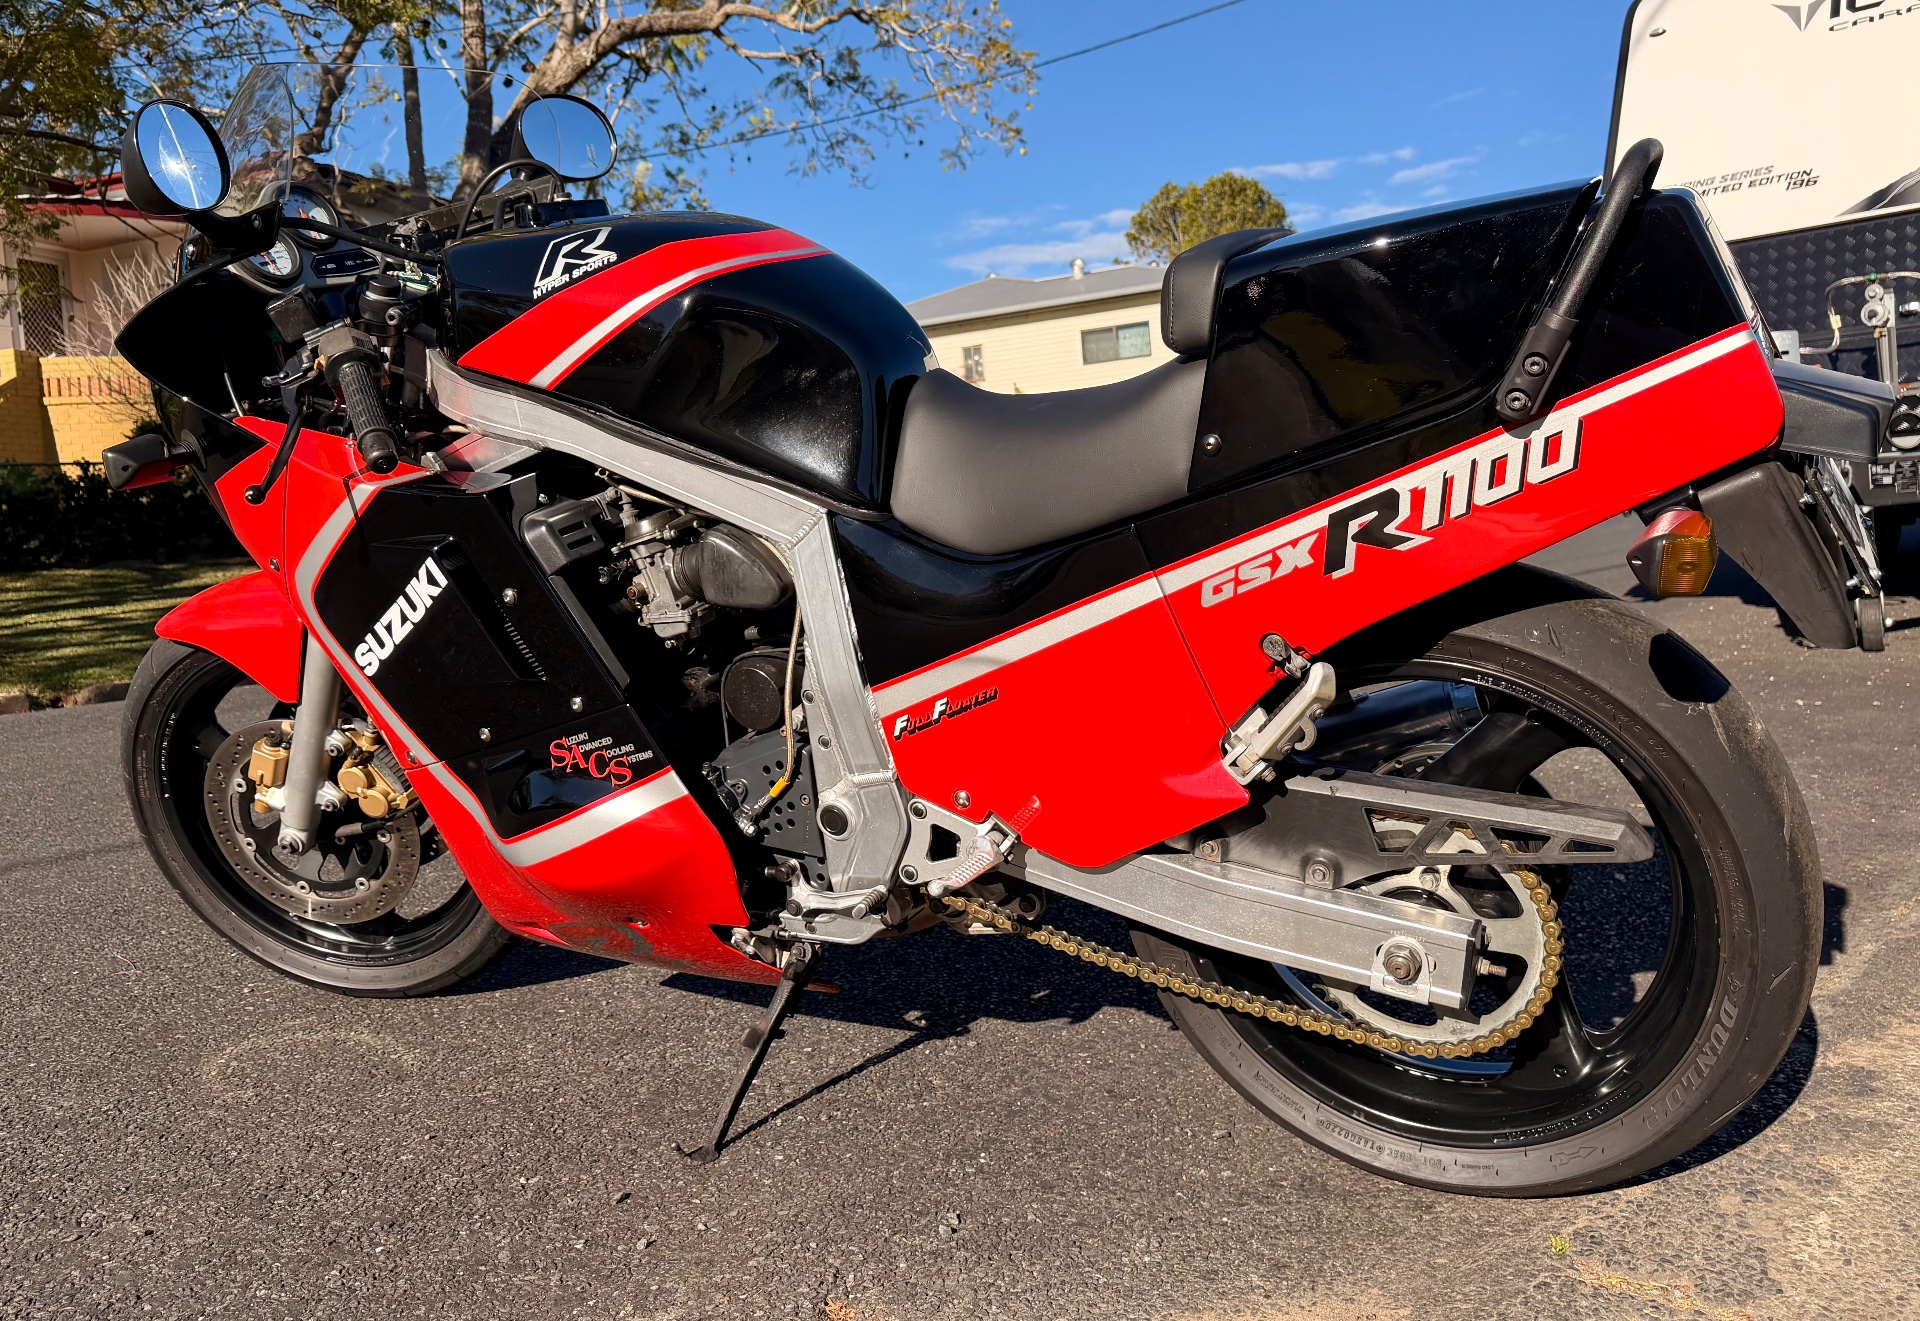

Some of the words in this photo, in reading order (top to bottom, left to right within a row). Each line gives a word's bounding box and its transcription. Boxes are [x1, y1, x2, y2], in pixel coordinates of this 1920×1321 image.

[1719, 165, 1775, 184] SERIES
[1748, 168, 1814, 188] EDITION
[1786, 175, 1820, 191] 196
[533, 273, 570, 299] HYPER
[572, 253, 618, 278] SPORTS
[1201, 533, 1318, 609] GSX
[354, 556, 449, 677] SUZUKI
[1646, 996, 1741, 1130] DUNLOP
